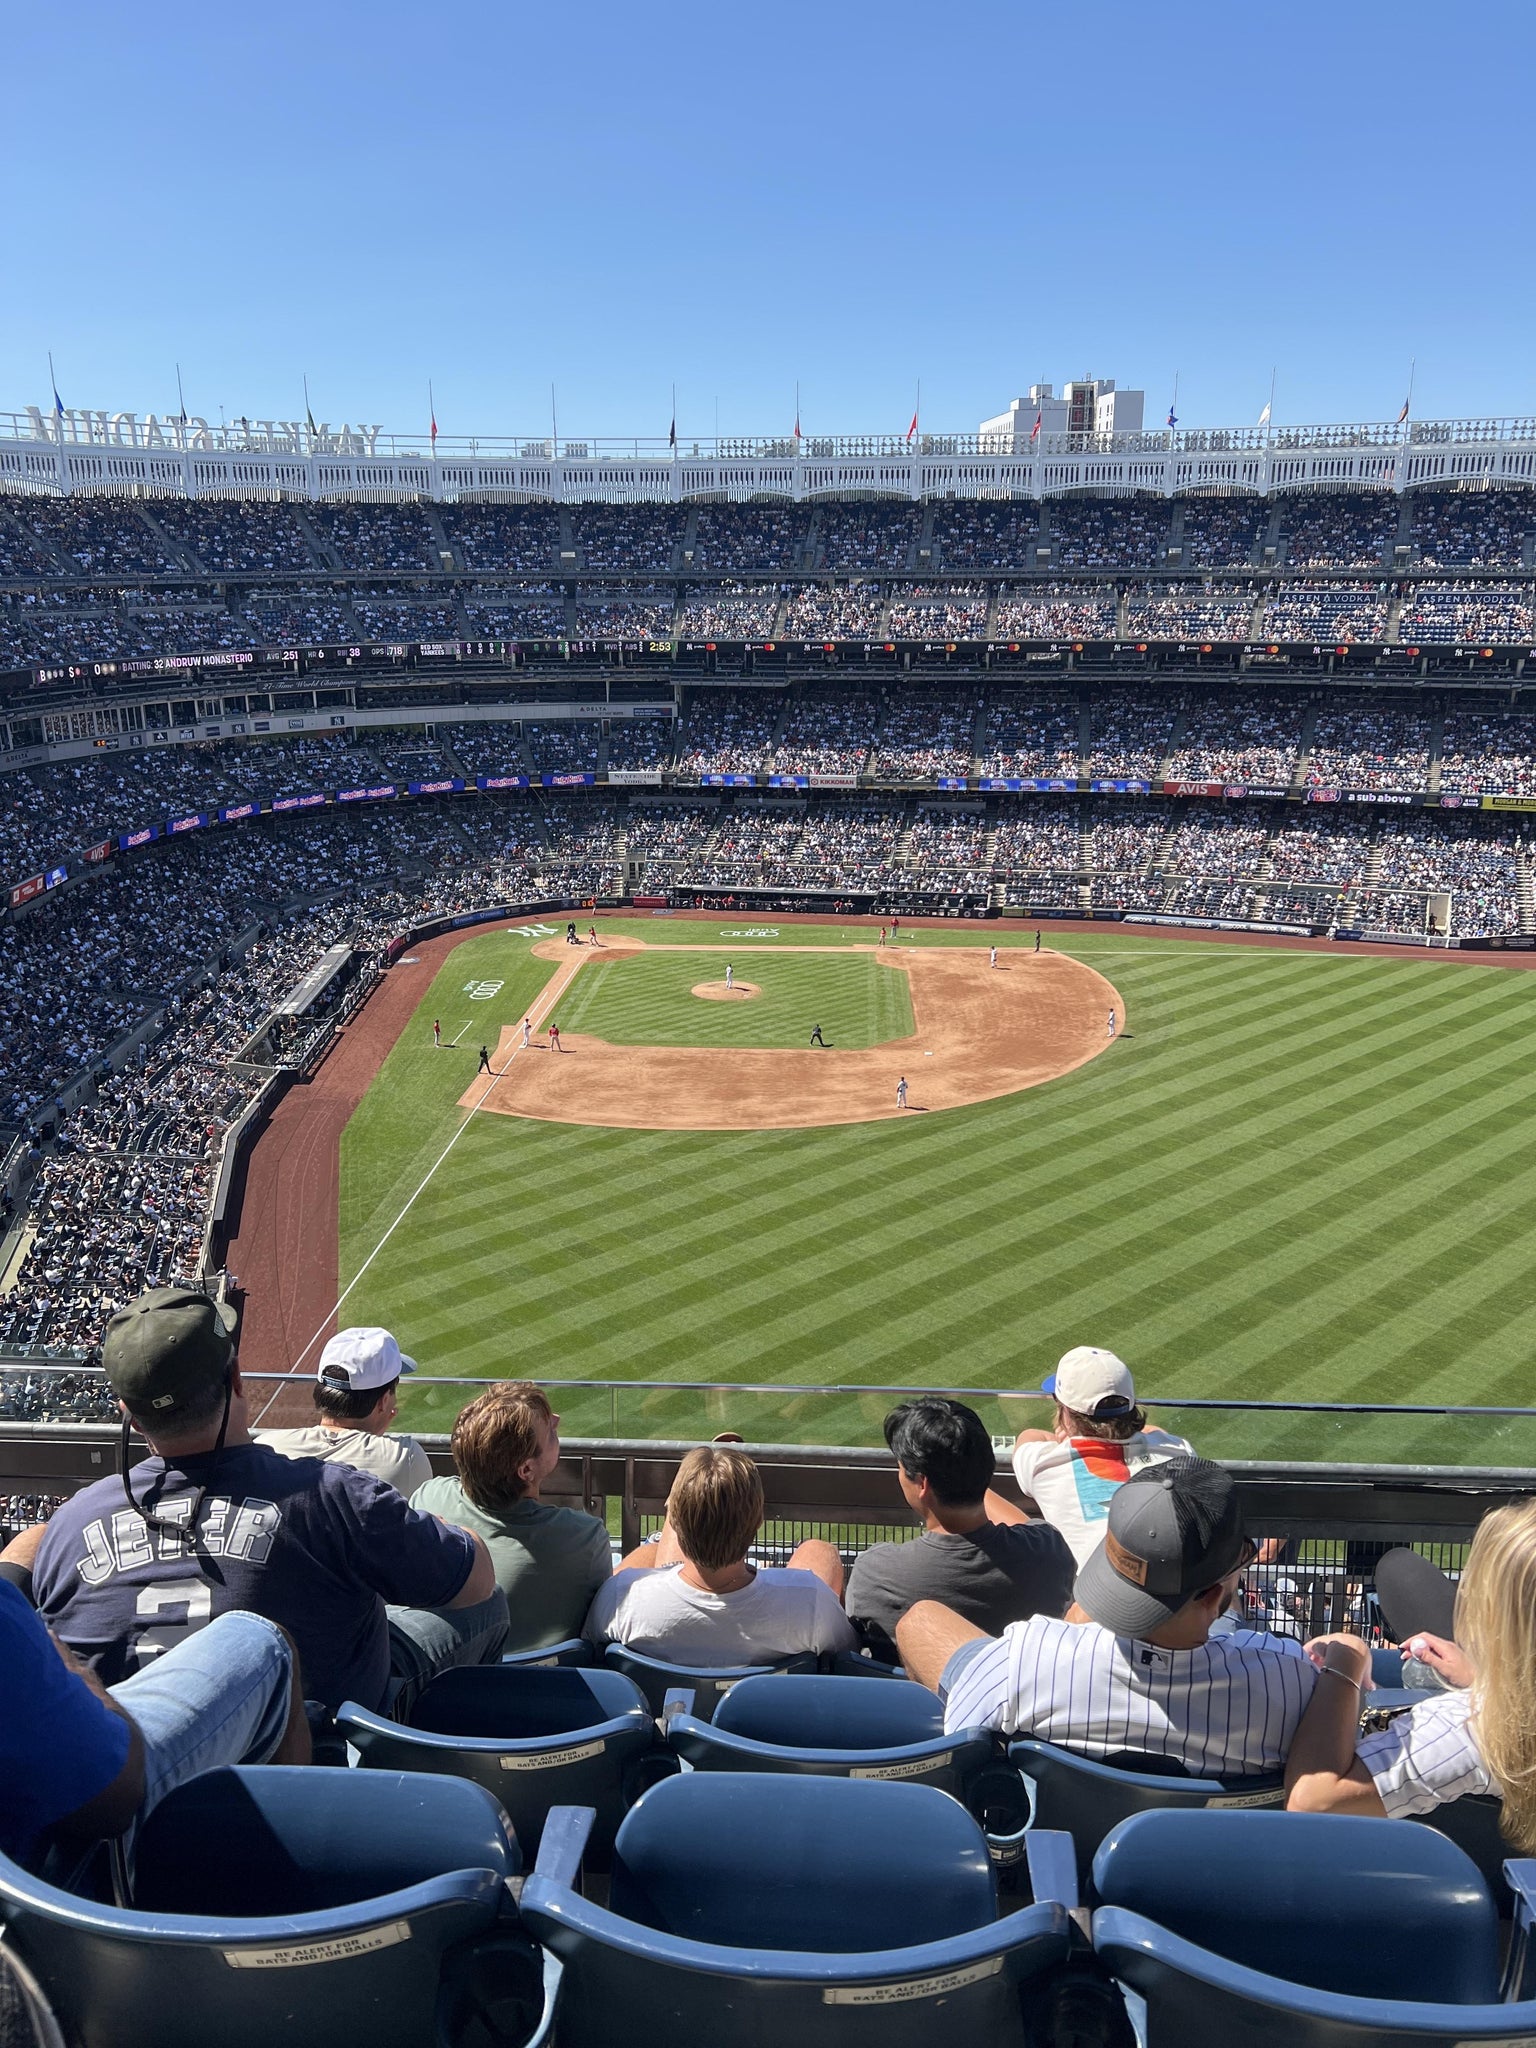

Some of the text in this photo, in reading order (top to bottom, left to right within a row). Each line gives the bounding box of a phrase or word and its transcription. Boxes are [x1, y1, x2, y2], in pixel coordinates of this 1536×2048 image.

[1284, 594, 1371, 603] ASPEN VODKA
[1421, 595, 1515, 604] ASPEN VODKA
[349, 648, 360, 656] 38
[387, 646, 402, 656] .718
[650, 642, 671, 651] 2:53
[266, 650, 298, 660] AVG .251
[318, 650, 324, 659] 6
[122, 653, 253, 672] BATTING: 32 ANDRUW MONASTERIO
[40, 670, 46, 681] B
[68, 666, 75, 678] S
[11, 753, 28, 762] DELTA
[1176, 784, 1208, 795] AVIS
[1357, 793, 1376, 802] sub
[1377, 794, 1412, 803] above
[90, 846, 104, 860] AVIS
[76, 1495, 283, 1584] JETER
[135, 1577, 212, 1670] 2
[537, 1758, 566, 1766] AND/OR
[568, 1751, 589, 1762] BALLS
[916, 1763, 937, 1772] BALLS
[291, 1949, 342, 1964] AND/OR
[345, 1939, 383, 1954] BALLS
[295, 1945, 333, 1957] ALERT
[336, 1939, 359, 1950] FOR
[853, 1974, 976, 2002] BATS AND/OR BALLS
[896, 1982, 933, 1994] ALERT
[936, 1975, 958, 1986] FOR
